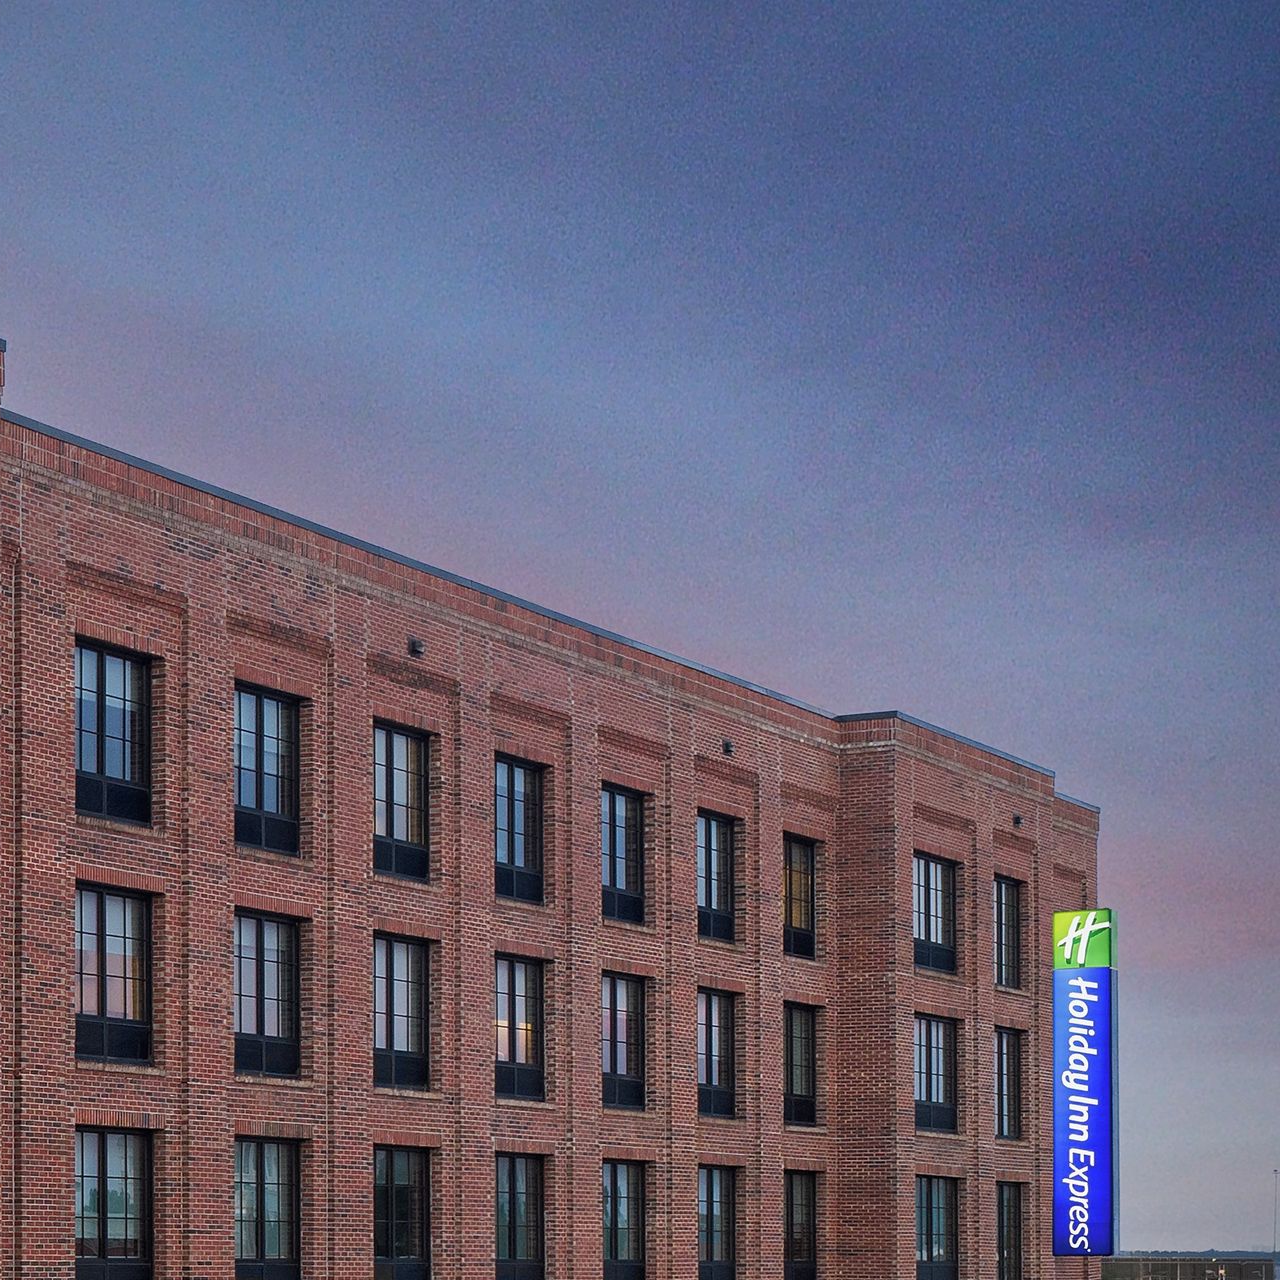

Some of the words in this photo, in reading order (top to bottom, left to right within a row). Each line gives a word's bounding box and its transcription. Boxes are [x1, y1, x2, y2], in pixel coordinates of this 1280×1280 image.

[1061, 976, 1099, 1092] Holiday
[1068, 1095, 1099, 1142] Inn
[1061, 1147, 1095, 1250] Express
